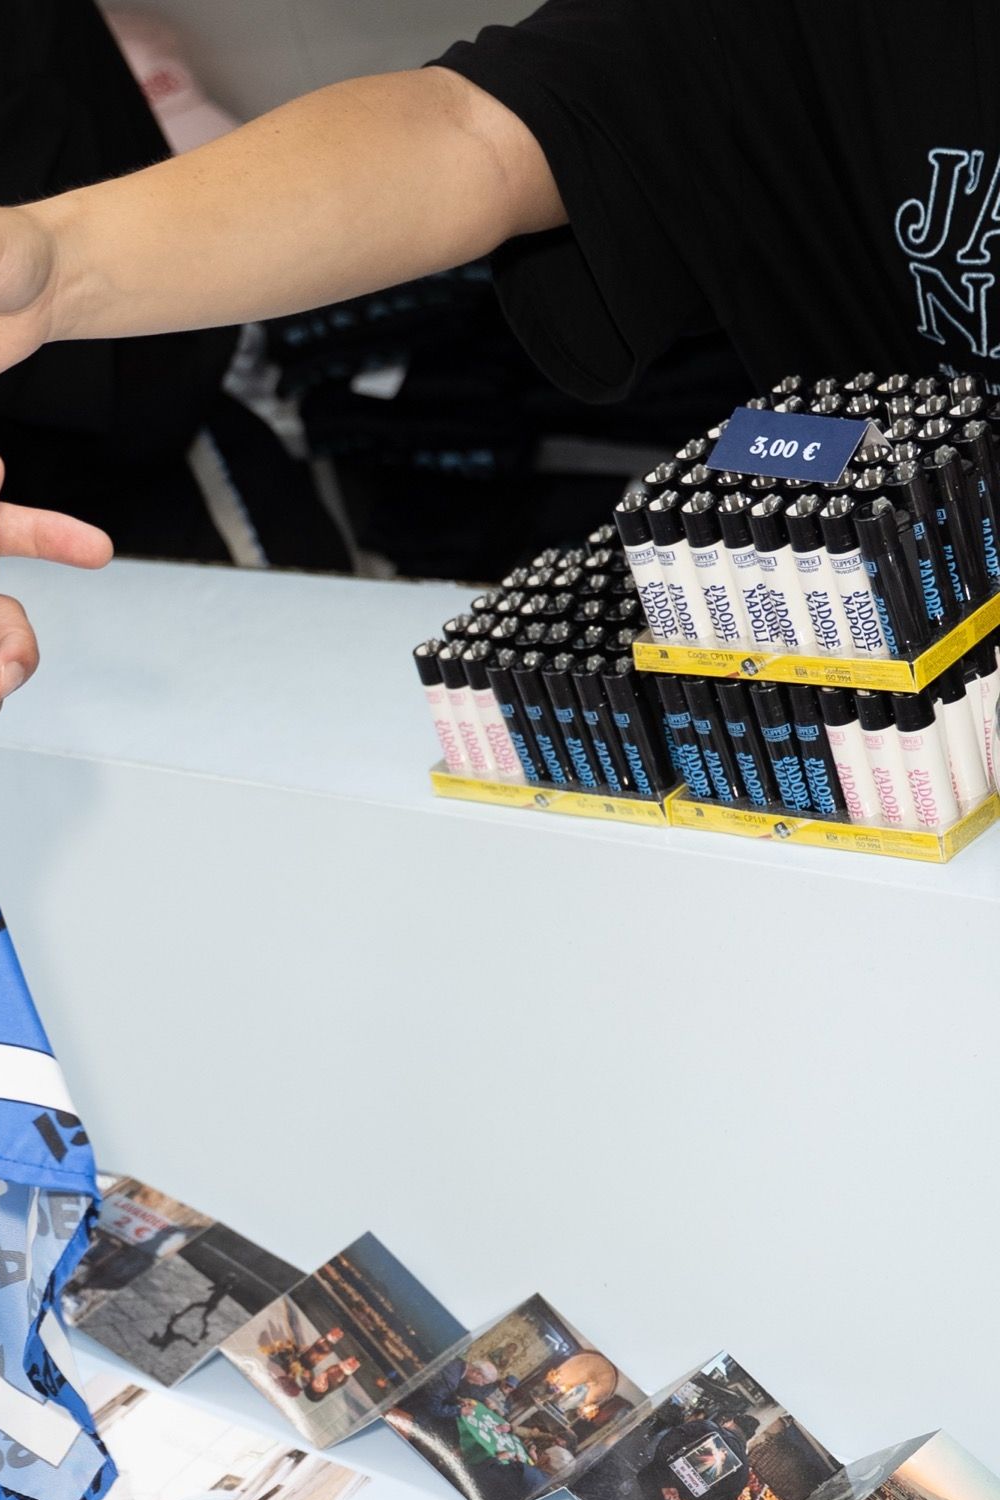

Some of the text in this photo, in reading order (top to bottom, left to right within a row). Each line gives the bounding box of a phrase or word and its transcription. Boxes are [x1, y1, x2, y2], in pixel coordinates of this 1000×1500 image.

[748, 436, 821, 463] 3,00 €
[648, 582, 678, 639] J'ADORE
[669, 584, 698, 641] J'ADORE
[710, 585, 740, 642] J'ADORE
[743, 588, 770, 643] NAPOLI
[770, 589, 799, 647] J'ADORE
[919, 559, 944, 620] J'ADORE
[812, 591, 841, 650] J'ADORE
[841, 594, 868, 652] NAPOLI
[853, 591, 883, 651] J'ADORE
[536, 733, 569, 786] J'ADORE
[565, 736, 597, 789] J'ADORE
[594, 739, 622, 793] J'ADORE
[623, 742, 653, 797] J'ADORE
[682, 743, 712, 799] J'ADORE
[703, 749, 734, 803] J'ADORE
[736, 752, 768, 807] J'ADORE
[782, 756, 812, 812] J'ADORE
[808, 757, 837, 815] J'ADORE
[837, 762, 864, 819] J'ADORE
[872, 767, 902, 825] J'ADORE
[913, 769, 940, 827] J'ADORE
